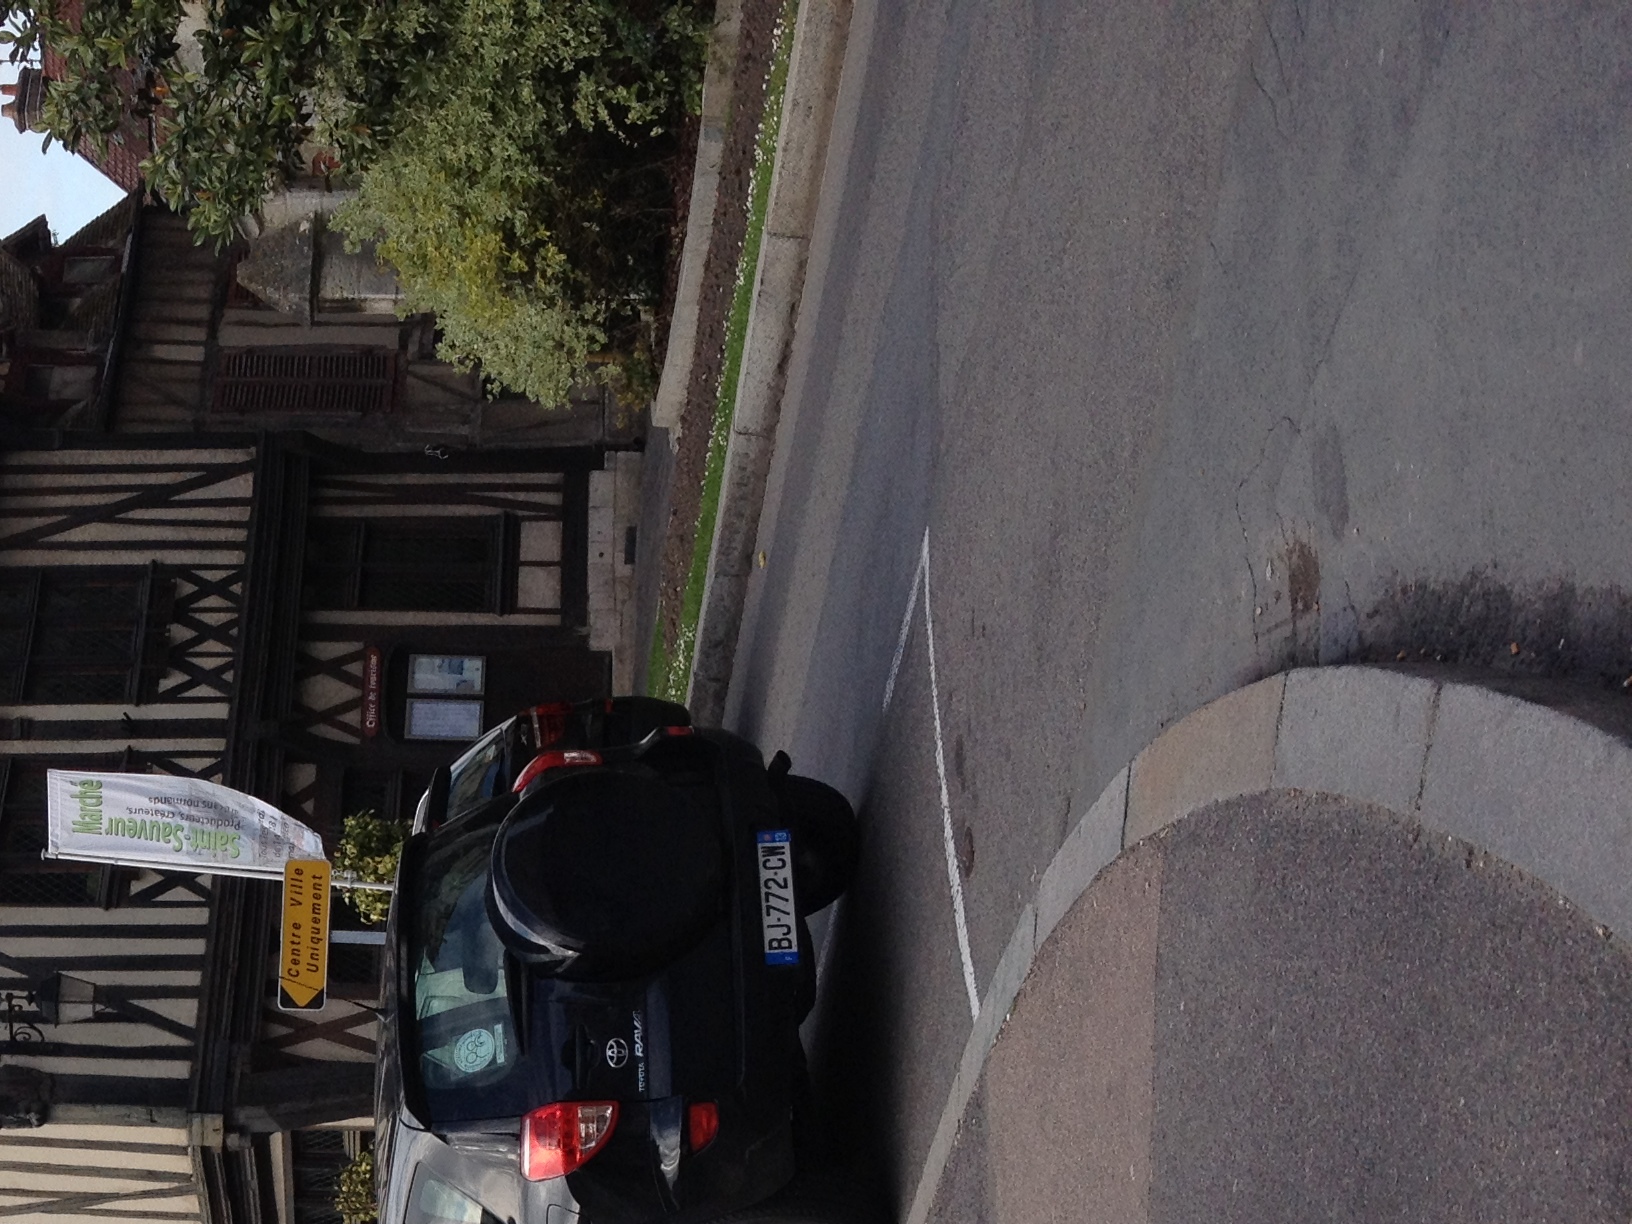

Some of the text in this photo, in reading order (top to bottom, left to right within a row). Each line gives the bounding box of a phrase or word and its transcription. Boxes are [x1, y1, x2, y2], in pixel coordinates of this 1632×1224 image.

[366, 654, 380, 728] Office de tourisme
[69, 779, 103, 836] Marché
[104, 816, 242, 859] Saint-Sauveur
[179, 811, 242, 831] Producteurs,
[286, 868, 304, 978] Centre Ville
[306, 874, 323, 973] Uniquement
[760, 846, 792, 950] BJ-772-CW
[632, 1010, 644, 1057] RAV4
